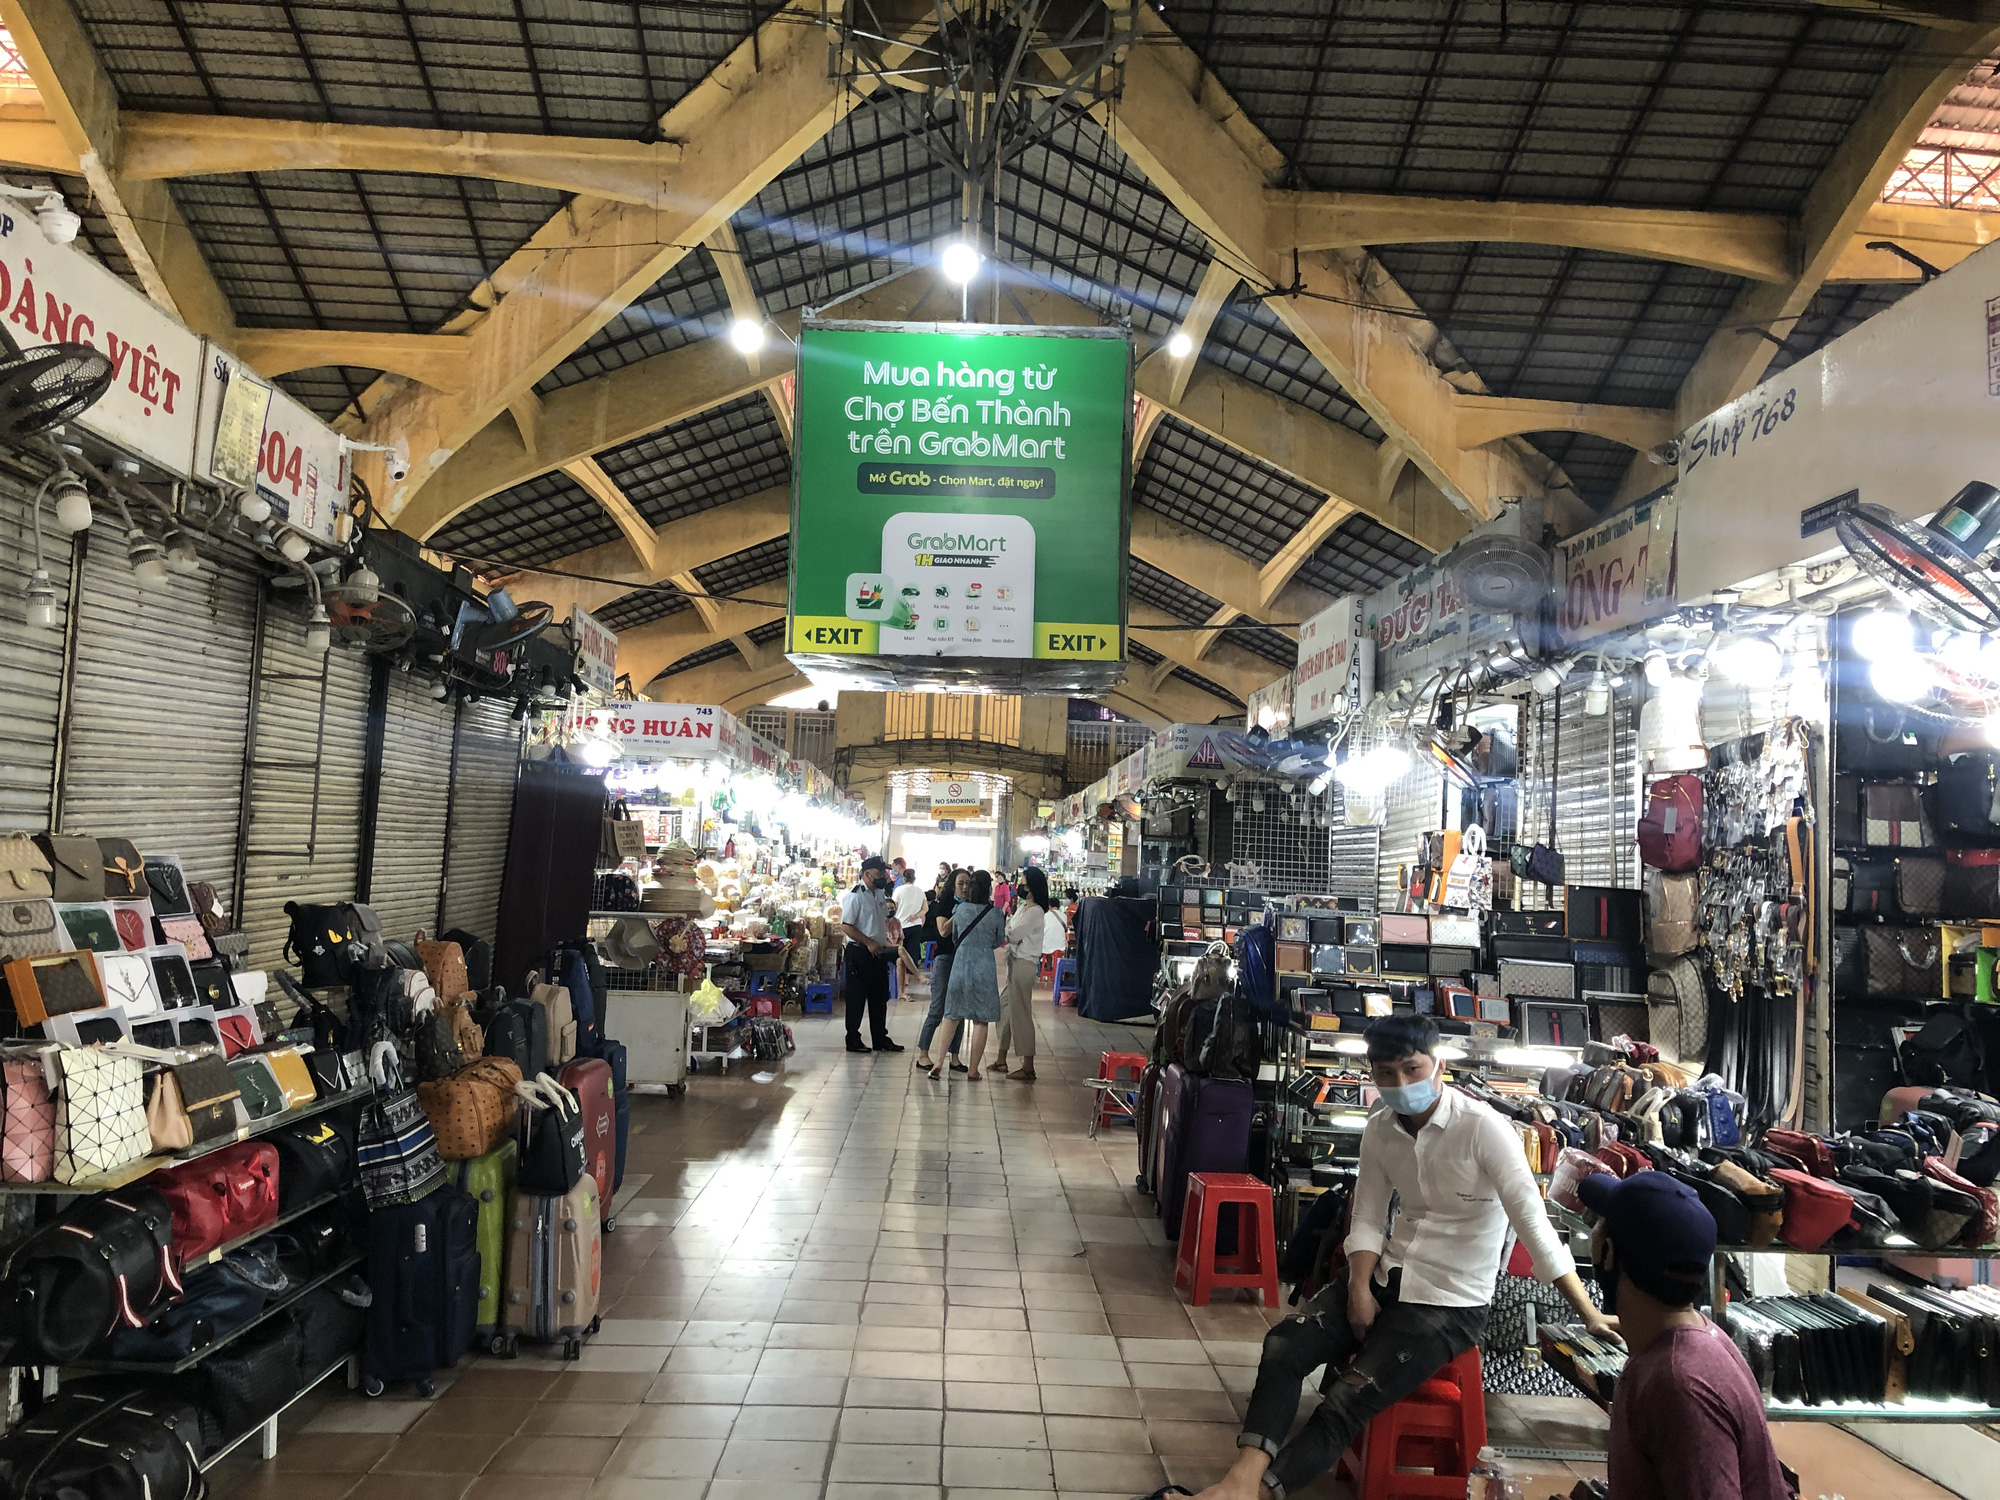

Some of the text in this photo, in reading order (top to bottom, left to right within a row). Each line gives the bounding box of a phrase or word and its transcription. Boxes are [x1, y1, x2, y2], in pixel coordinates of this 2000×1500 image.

[106, 331, 181, 417] VIỆT
[864, 361, 1058, 396] Mua hàng từ
[844, 395, 1071, 428] Chợ Bến Thành
[1685, 388, 1797, 475] Shop 768
[847, 428, 1066, 460] trên GrabMart
[869, 472, 886, 483] Mở
[889, 470, 931, 486] Grab
[939, 475, 966, 488] Chọn
[968, 476, 995, 488] Mart,
[998, 477, 1014, 489] đặt
[1016, 479, 1044, 490] ngay!
[907, 532, 1007, 552] GrabMart
[915, 554, 934, 567] 1H
[954, 557, 982, 565] NHANH
[815, 628, 863, 645] EXIT
[1049, 634, 1096, 651] EXIT
[696, 708, 713, 716] 743
[642, 717, 714, 739] HUÂN
